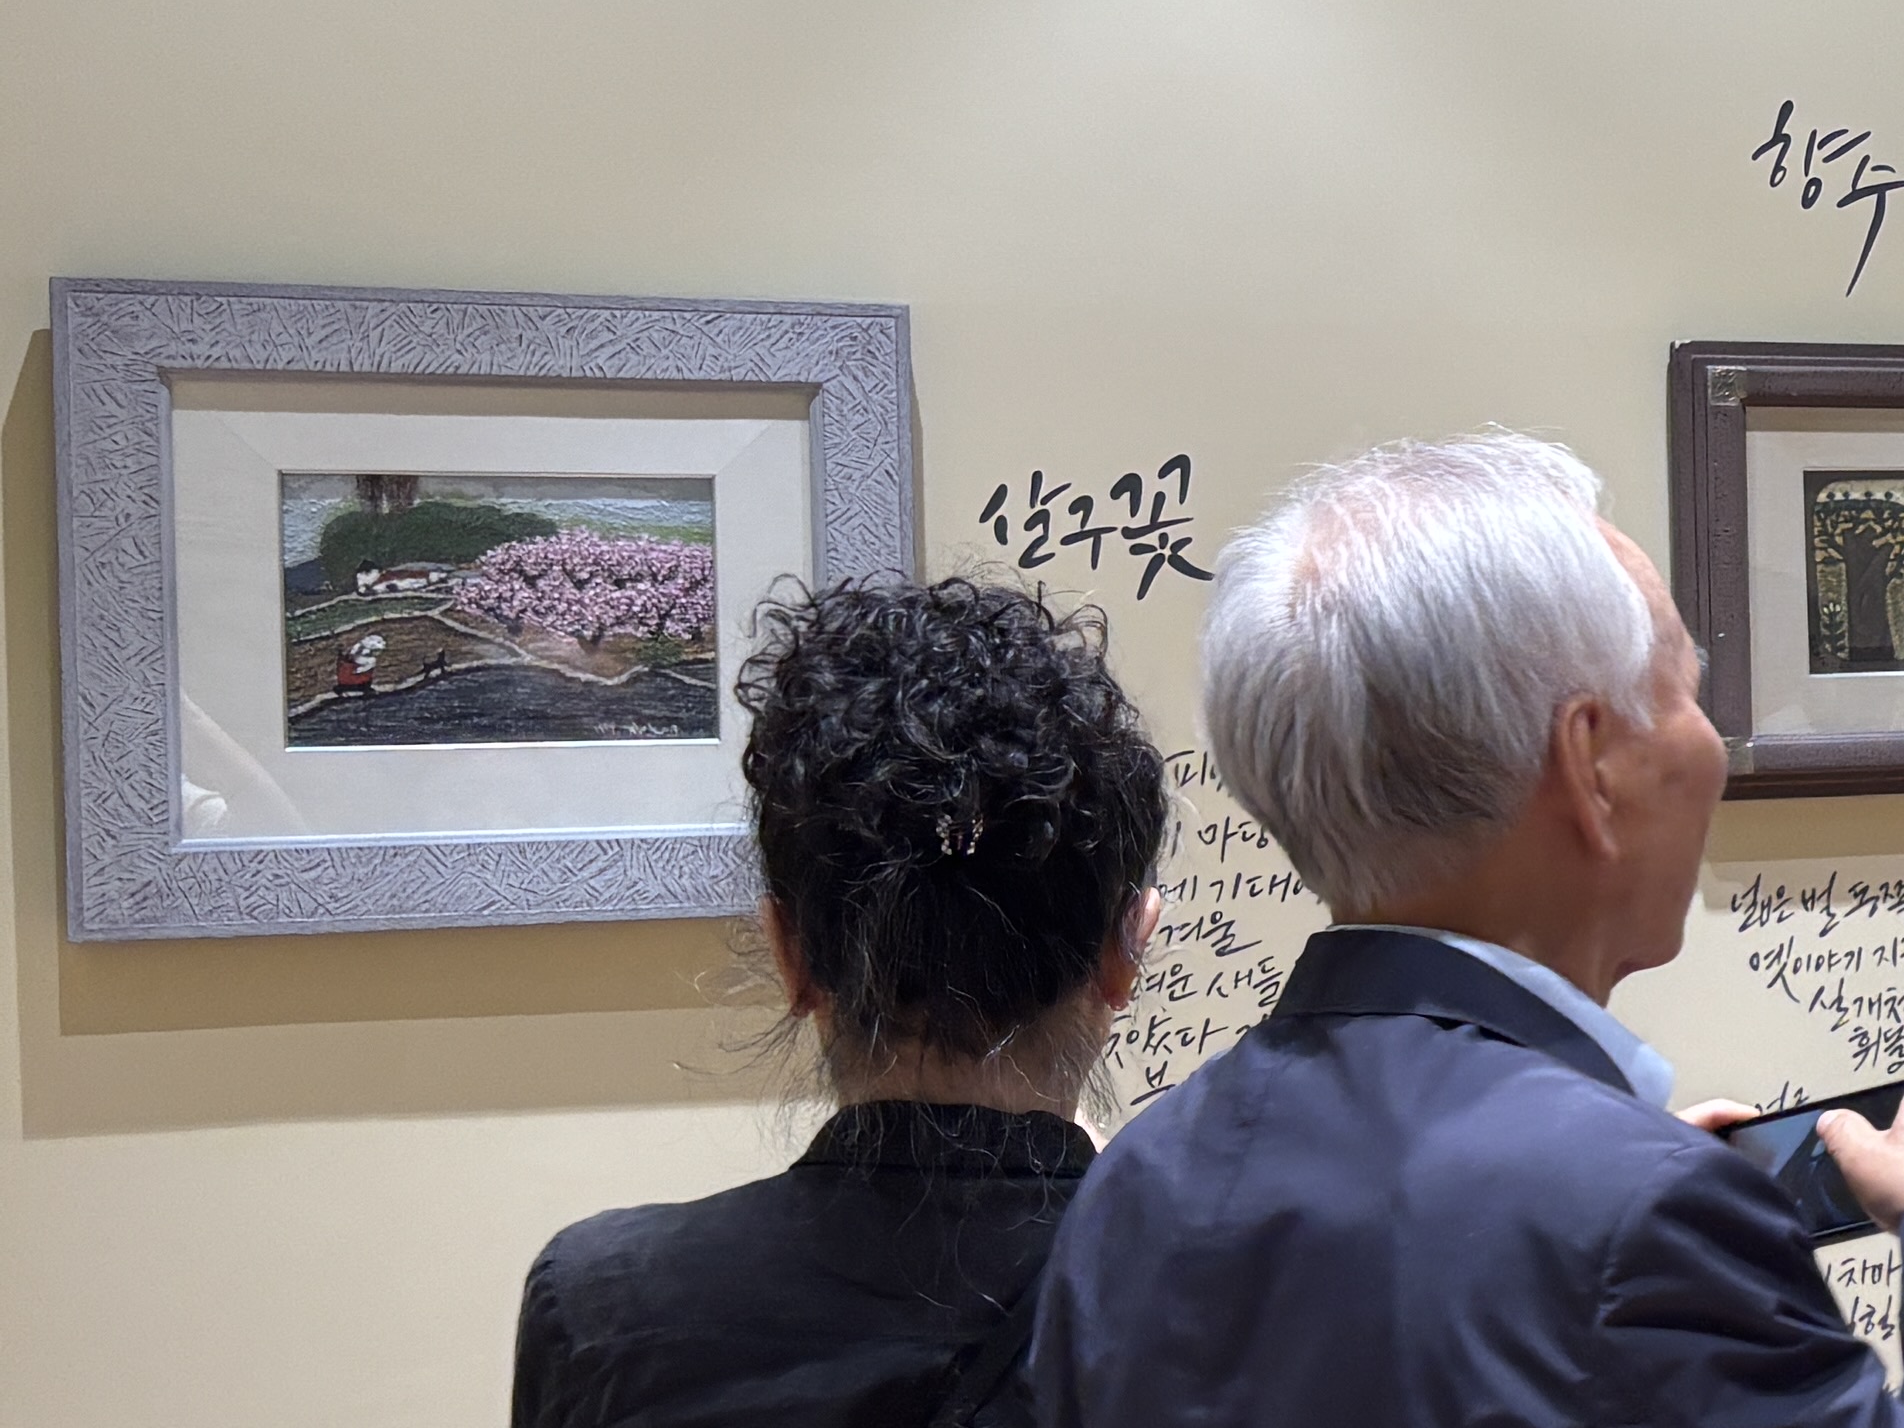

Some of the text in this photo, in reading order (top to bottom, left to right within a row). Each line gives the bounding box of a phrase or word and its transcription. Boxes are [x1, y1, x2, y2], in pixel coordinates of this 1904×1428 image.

[979, 453, 1215, 600] 살구꽃
[1158, 910, 1264, 958] 겨울
[1730, 872, 1798, 934] 넓은
[1801, 871, 1841, 938] 벌
[1206, 956, 1284, 1008] 새들
[1748, 936, 1864, 1003] 옛이야기
[1837, 1248, 1902, 1289] 차마
